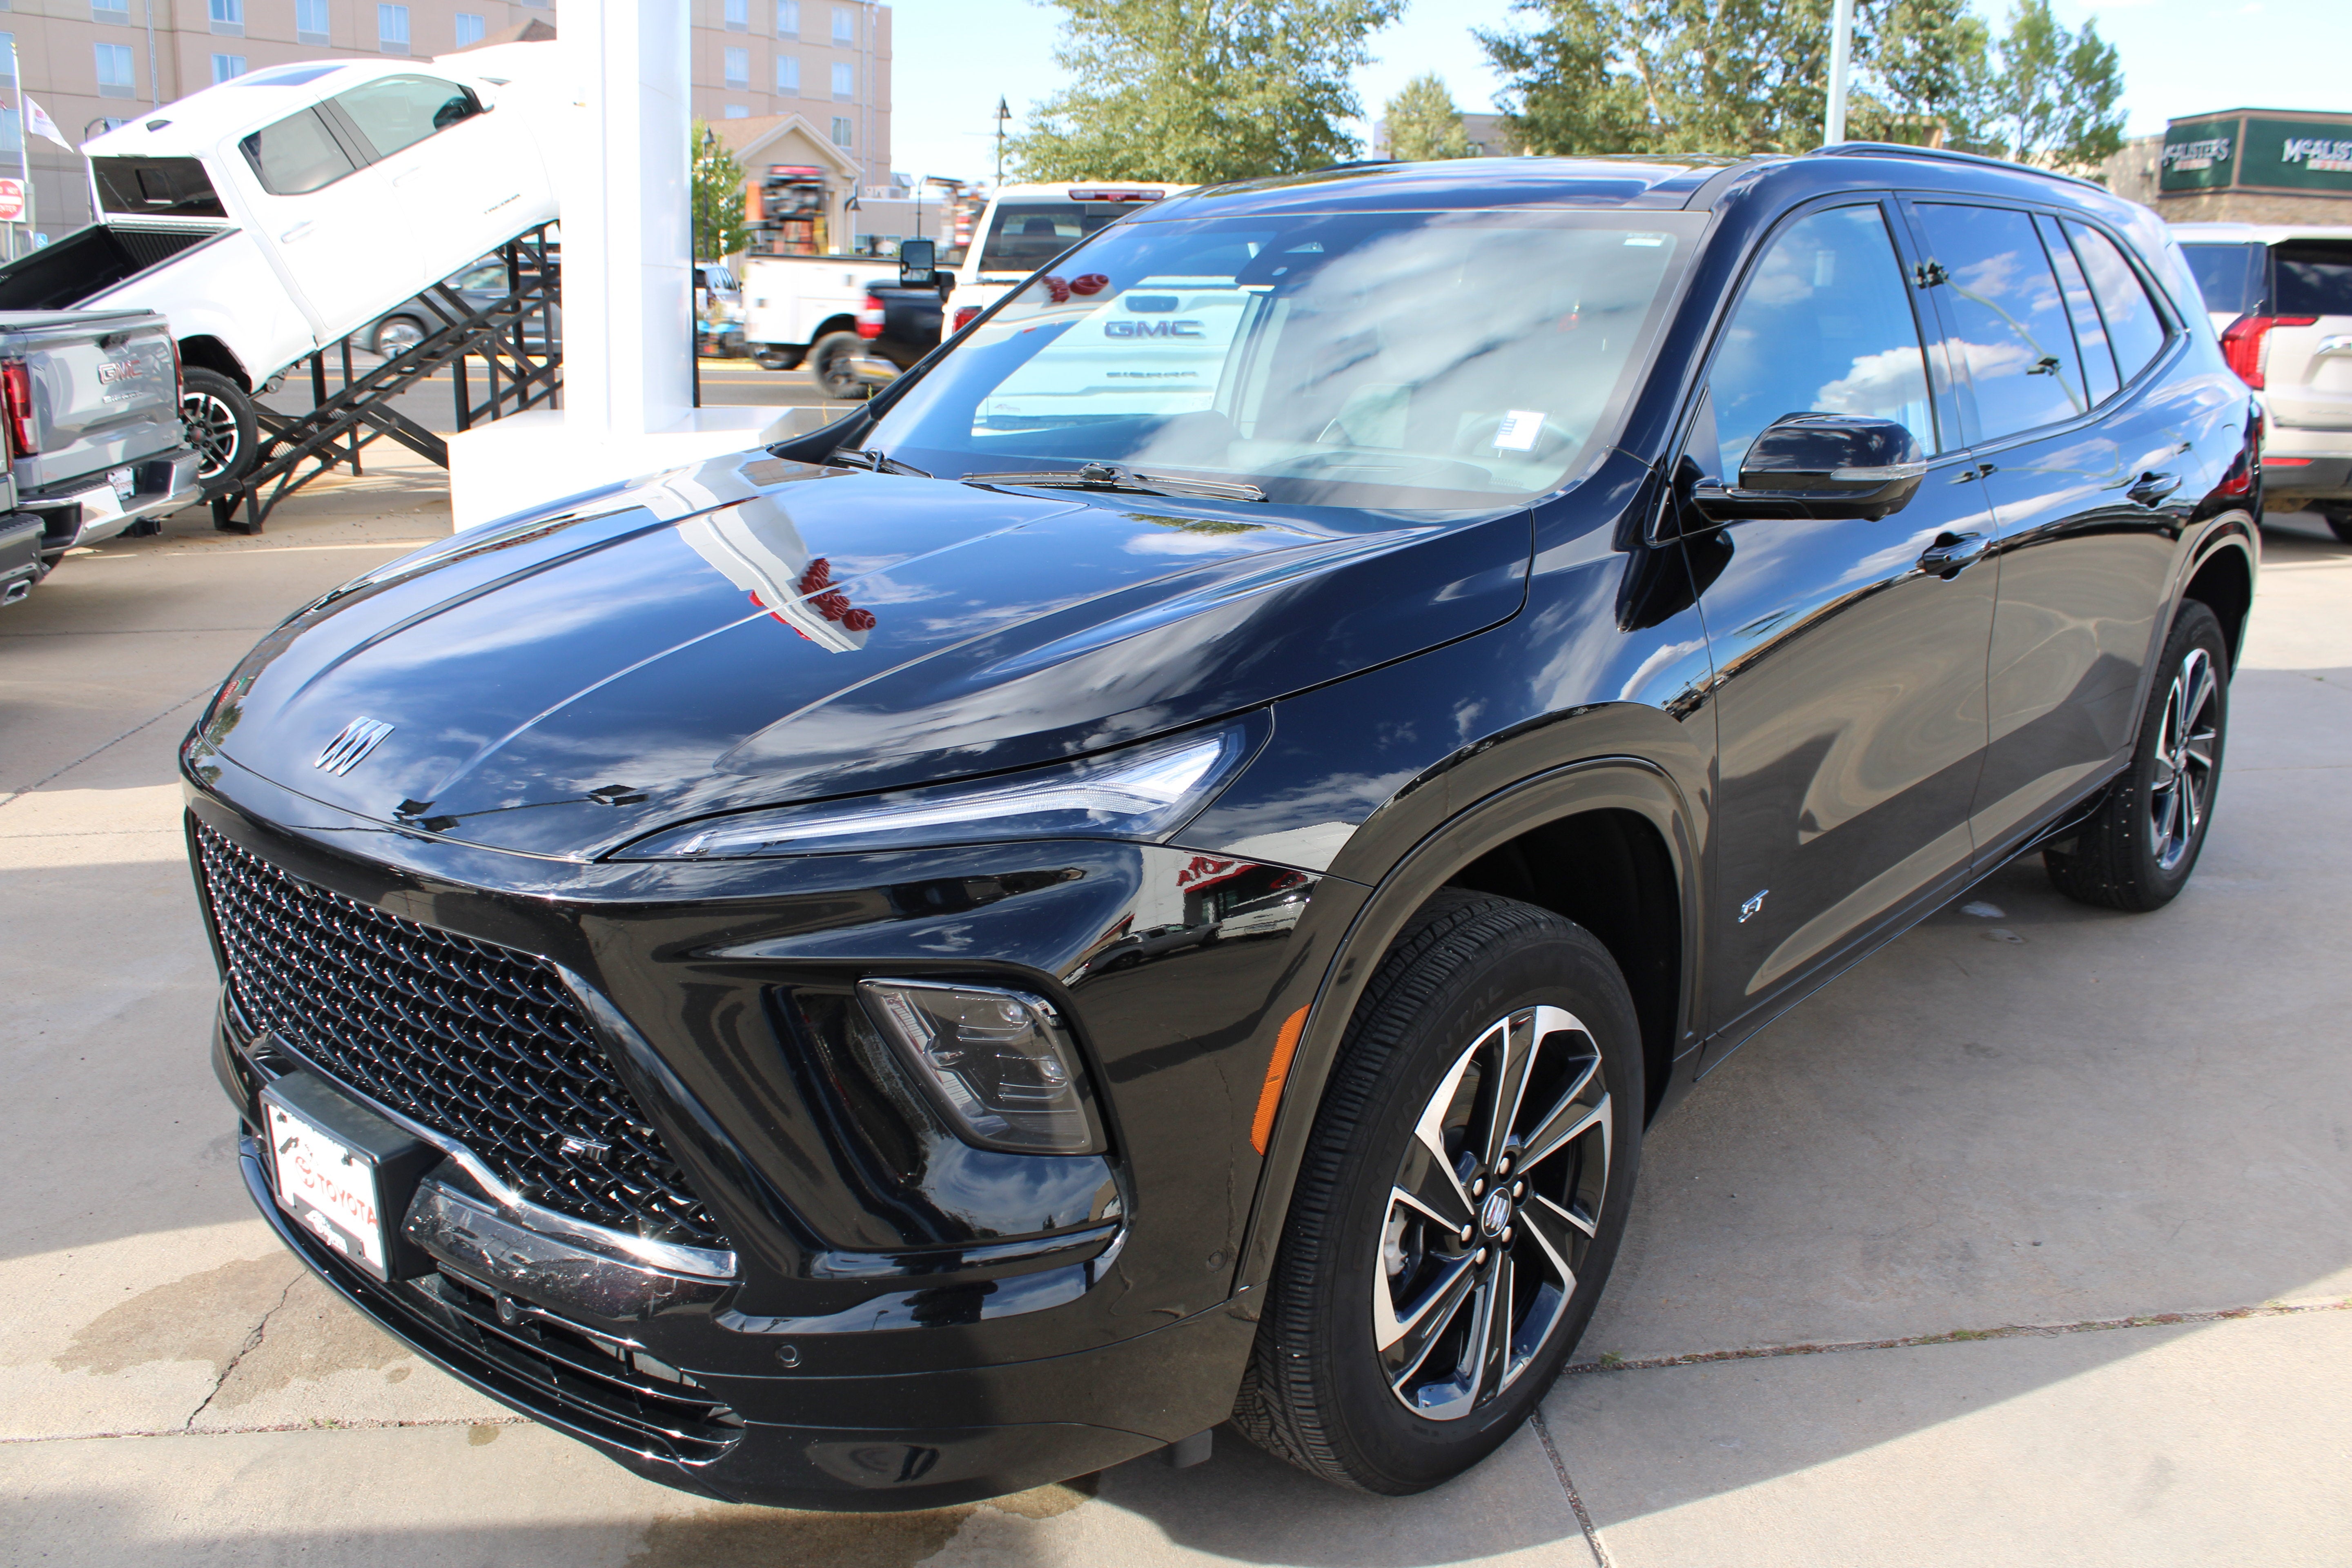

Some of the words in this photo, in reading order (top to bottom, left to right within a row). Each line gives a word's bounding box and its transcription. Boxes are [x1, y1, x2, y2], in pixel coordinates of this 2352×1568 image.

[1104, 320, 1206, 339] GMC
[98, 359, 143, 384] GMC
[317, 1173, 378, 1226] TOYOTA
